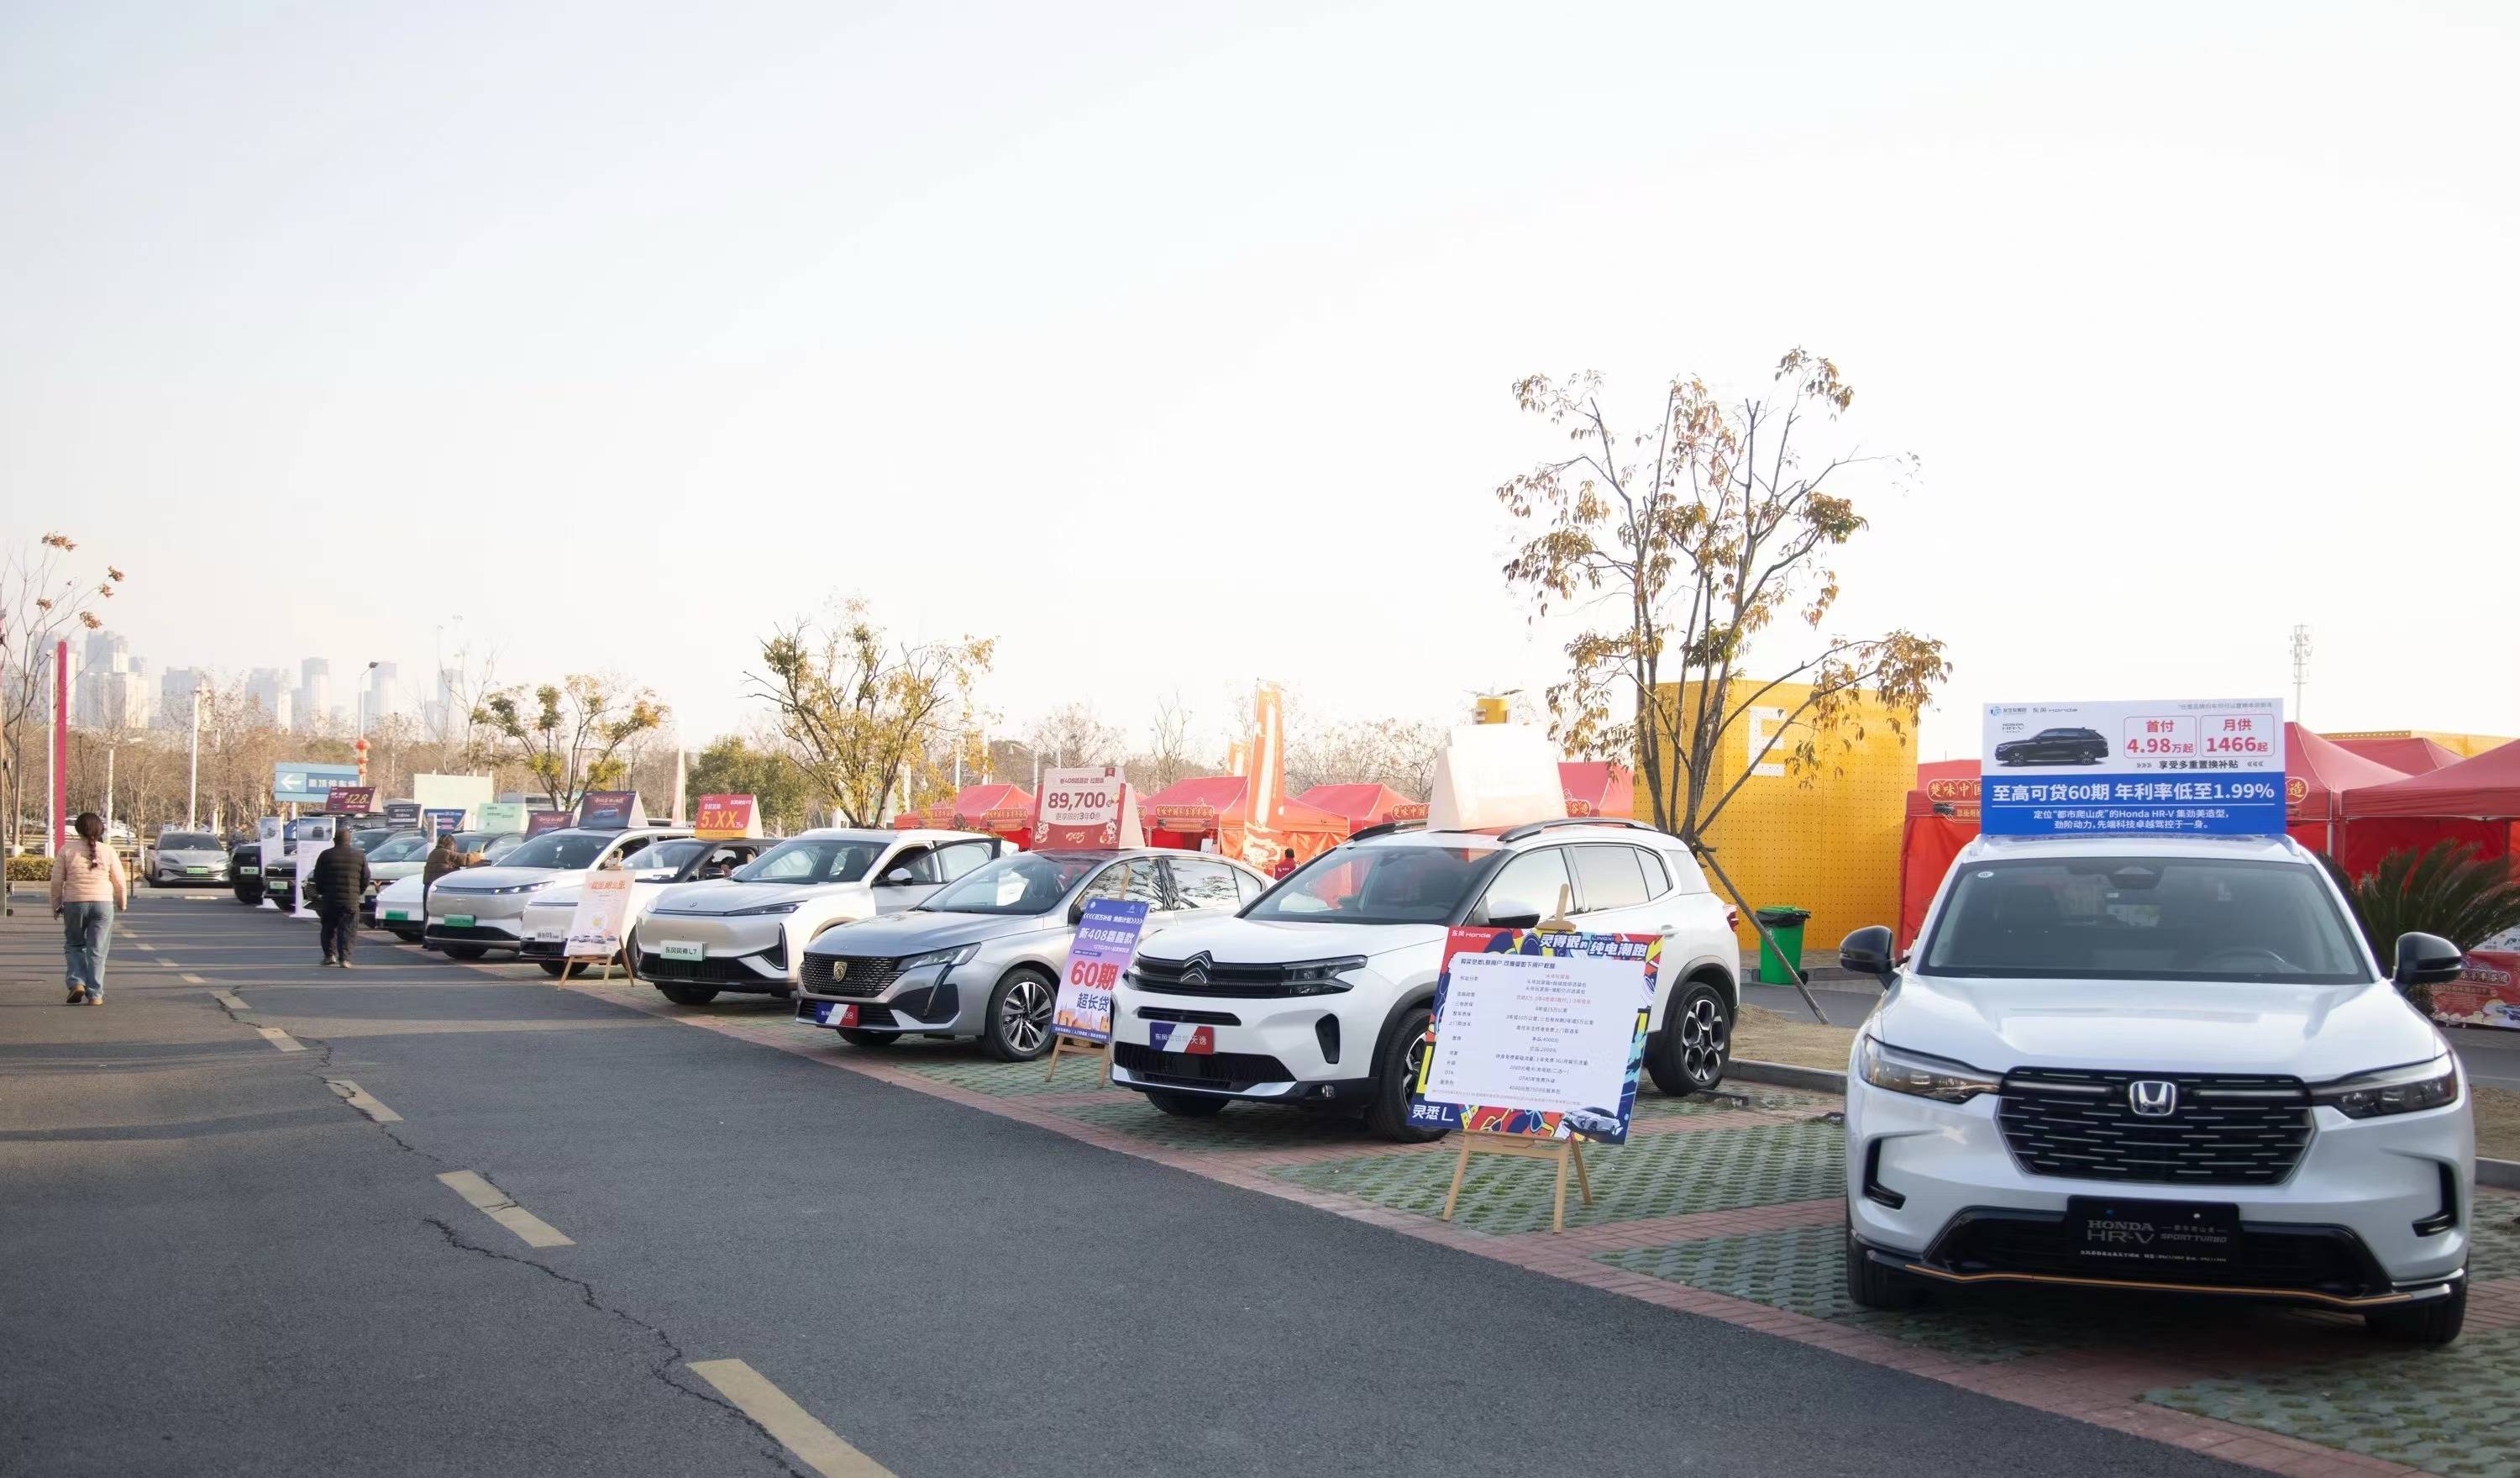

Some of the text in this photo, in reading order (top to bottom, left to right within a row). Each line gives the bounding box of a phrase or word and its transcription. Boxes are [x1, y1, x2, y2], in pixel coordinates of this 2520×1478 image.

[2146, 720, 2174, 734] 首付
[2223, 718, 2252, 732] 月供
[2127, 738, 2193, 754] 4.98万起
[2207, 737, 2268, 752] 1466起
[2159, 760, 2239, 770] 享受多重置换补贴
[1992, 782, 2275, 802] 至高可贷60期 年利率低至1.99%
[2288, 781, 2305, 798] 造
[1047, 792, 1105, 811] 89,700
[701, 811, 738, 828] 5.XX
[1589, 941, 1647, 957] 纯电潮跑
[1070, 960, 1120, 991] 60期
[1077, 992, 1109, 1013] 超长贷
[1412, 1104, 1454, 1122] 灵悉L
[2087, 1219, 2155, 1232] HONDA
[2087, 1229, 2155, 1244] HR-V
[2160, 1233, 2228, 1244] SPORT TURBO
